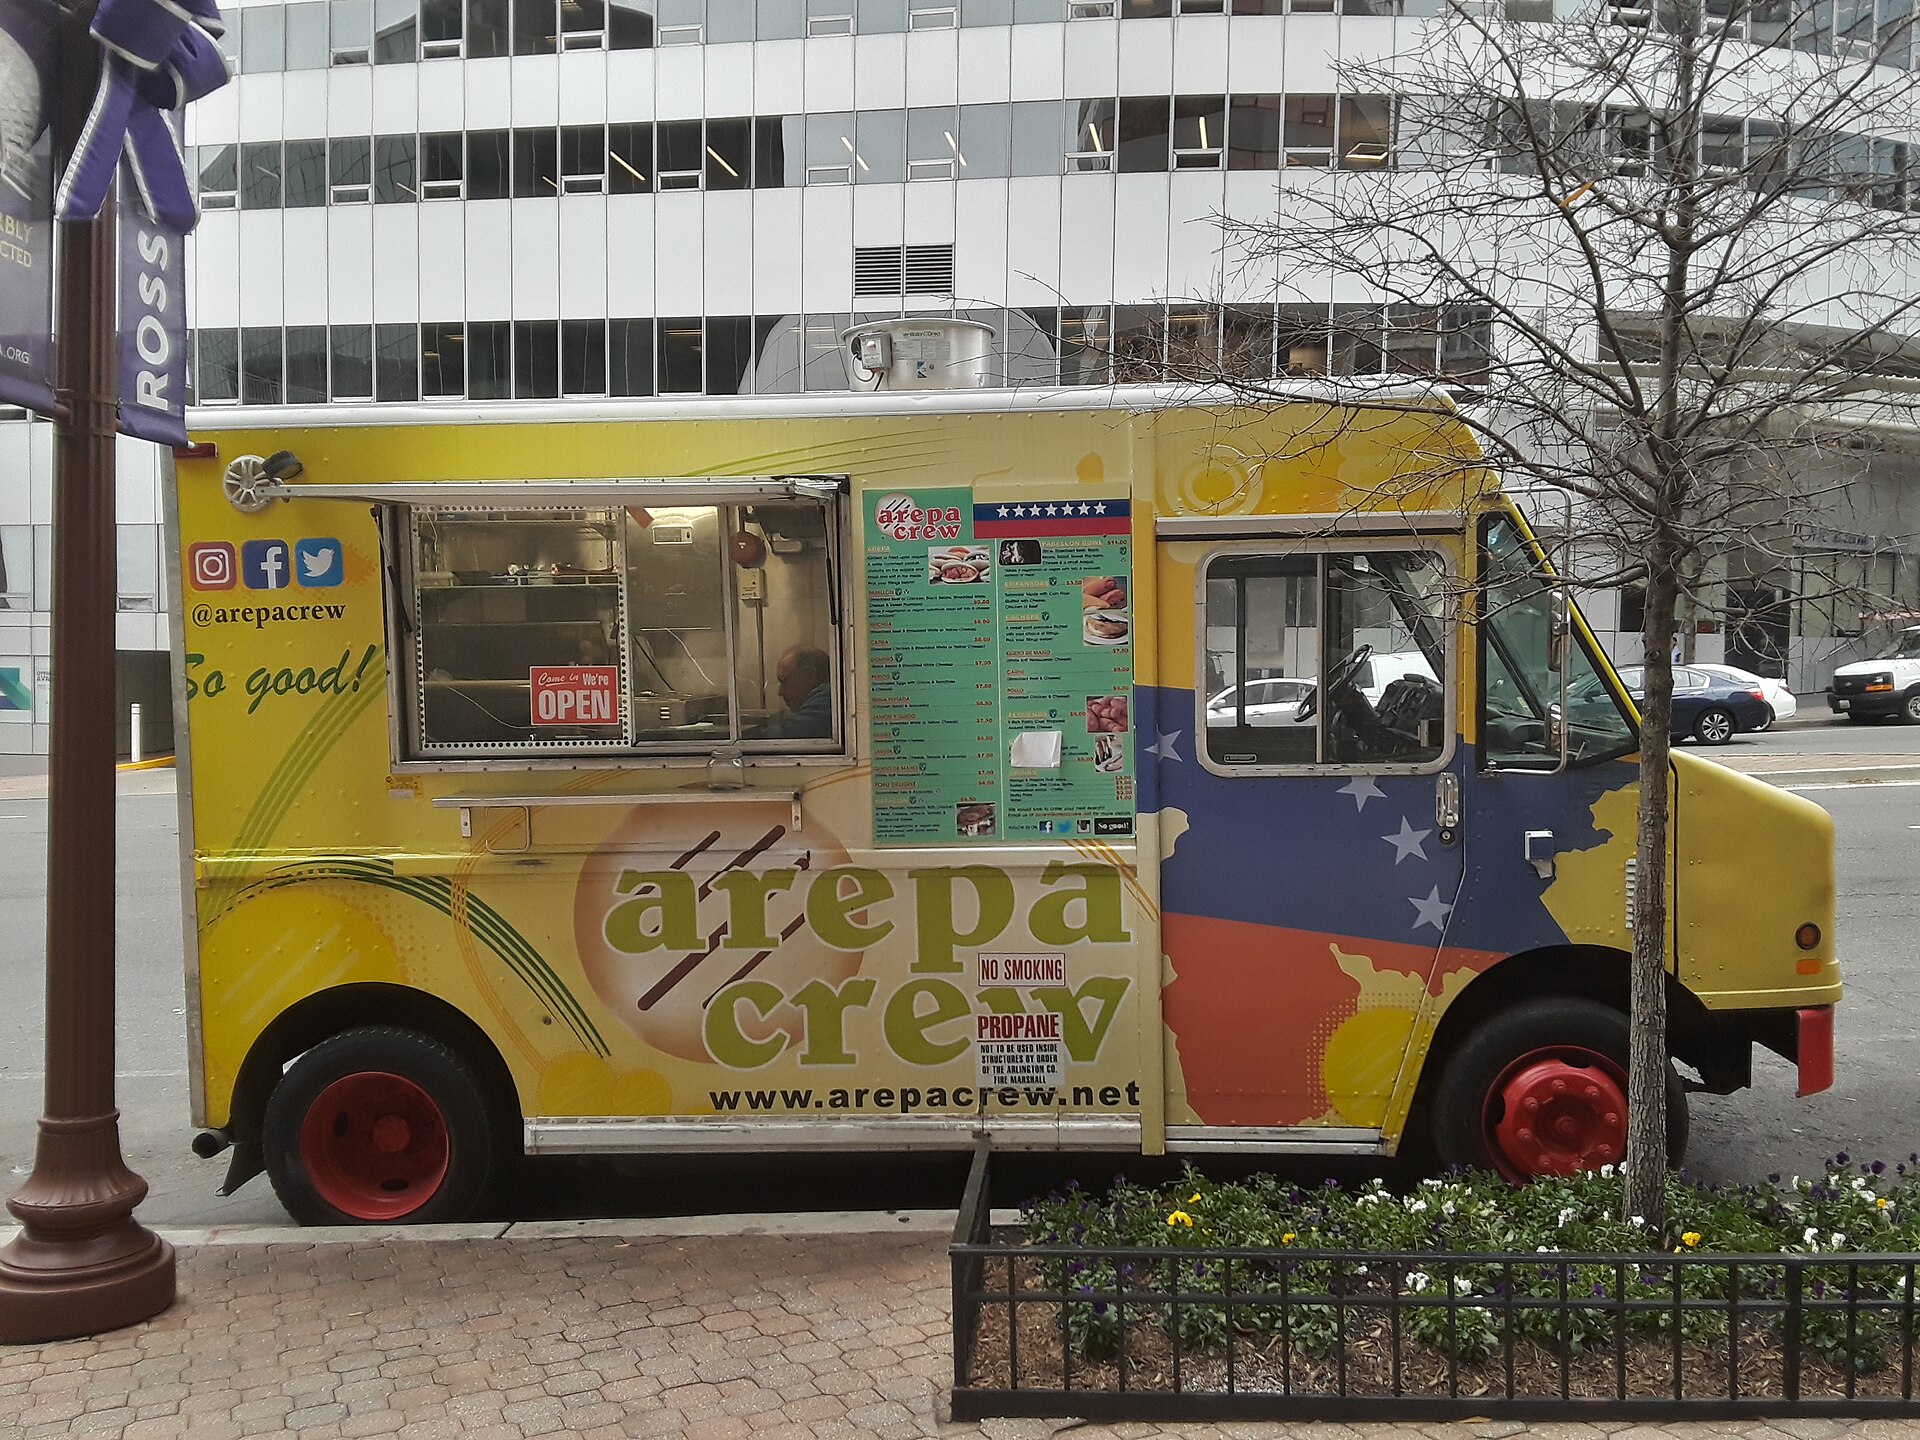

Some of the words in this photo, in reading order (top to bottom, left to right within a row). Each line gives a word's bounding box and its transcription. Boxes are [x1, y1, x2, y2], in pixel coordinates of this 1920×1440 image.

[136, 229, 171, 412] ROSS
[878, 506, 961, 526] arepa
[893, 523, 961, 541] crew
[192, 603, 346, 629] @arepacrew
[186, 653, 226, 699] So
[245, 644, 377, 714] good!
[538, 672, 565, 686] Come
[569, 672, 579, 681] in
[582, 672, 609, 686] We're
[538, 689, 611, 720] OPEN
[1097, 821, 1108, 831] So
[1108, 821, 1130, 831] good!
[603, 859, 1132, 974] arepa
[981, 958, 999, 980] NO
[1004, 958, 1063, 981] SMOKING
[704, 977, 1131, 1068] crew
[977, 1013, 1060, 1039] PROPANE
[980, 1044, 993, 1053] NOT
[996, 1044, 1005, 1053] TO
[1006, 1044, 1015, 1053] BE
[1017, 1044, 1034, 1053] USED
[1036, 1043, 1058, 1052] INSIDE
[981, 1055, 1023, 1064] STRUCTURES
[1025, 1055, 1035, 1063] BY
[1036, 1054, 1058, 1063] ORDER
[982, 1065, 990, 1074] OF
[993, 1065, 1005, 1074] THE
[1006, 1065, 1045, 1074] ARLINGTON
[993, 1075, 1009, 1084] FIRE
[1010, 1075, 1046, 1084] MARSHALL
[709, 1080, 1141, 1113] www.arepacrew.net
